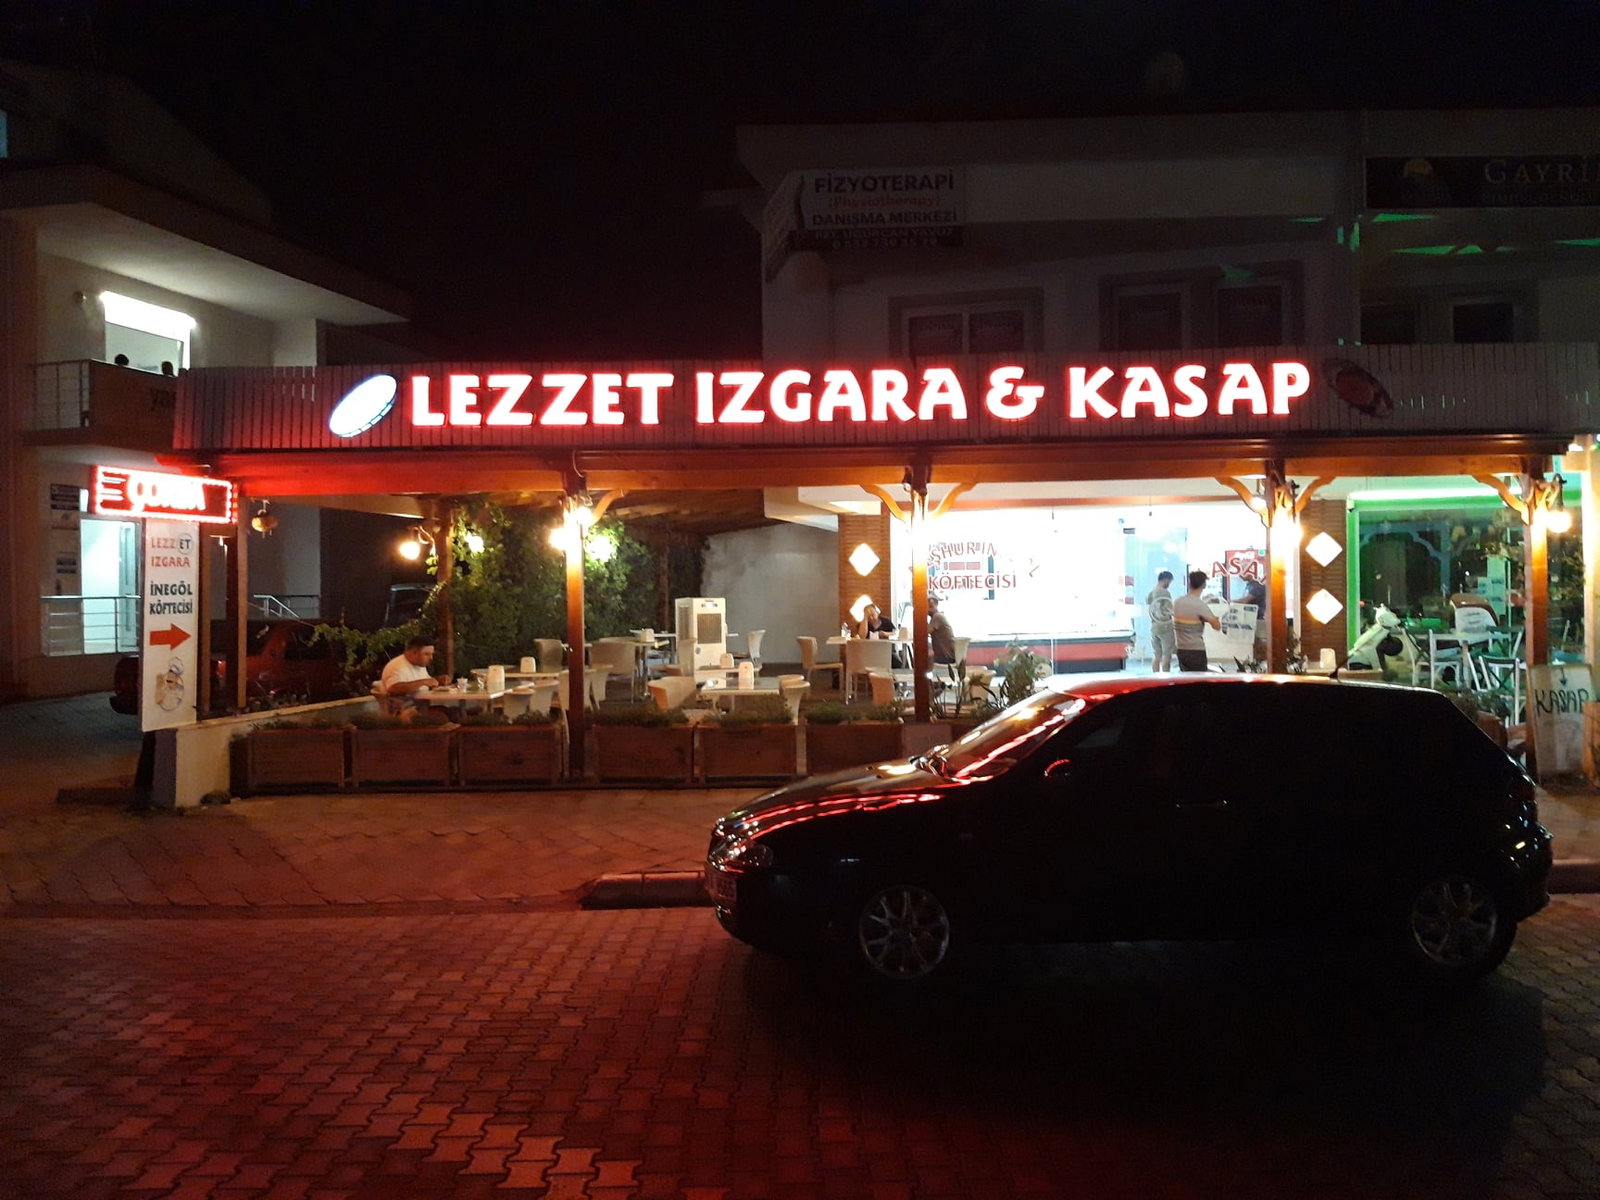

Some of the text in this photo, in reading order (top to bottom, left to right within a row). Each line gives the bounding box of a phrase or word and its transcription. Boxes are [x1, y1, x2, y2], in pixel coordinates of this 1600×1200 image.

[814, 170, 954, 193] FİZYOTERAPİ
[812, 208, 957, 226] DANIŞMA MERKEZİ
[412, 363, 1310, 427] LEZZET IZGARA & KASAP
[151, 556, 190, 567] IZGARA
[150, 580, 193, 596] İNEGÖL
[928, 570, 1016, 590] KÖFTECİSİ
[149, 599, 193, 615] KÖFTECİSİ
[1534, 688, 1589, 717] KASAP
